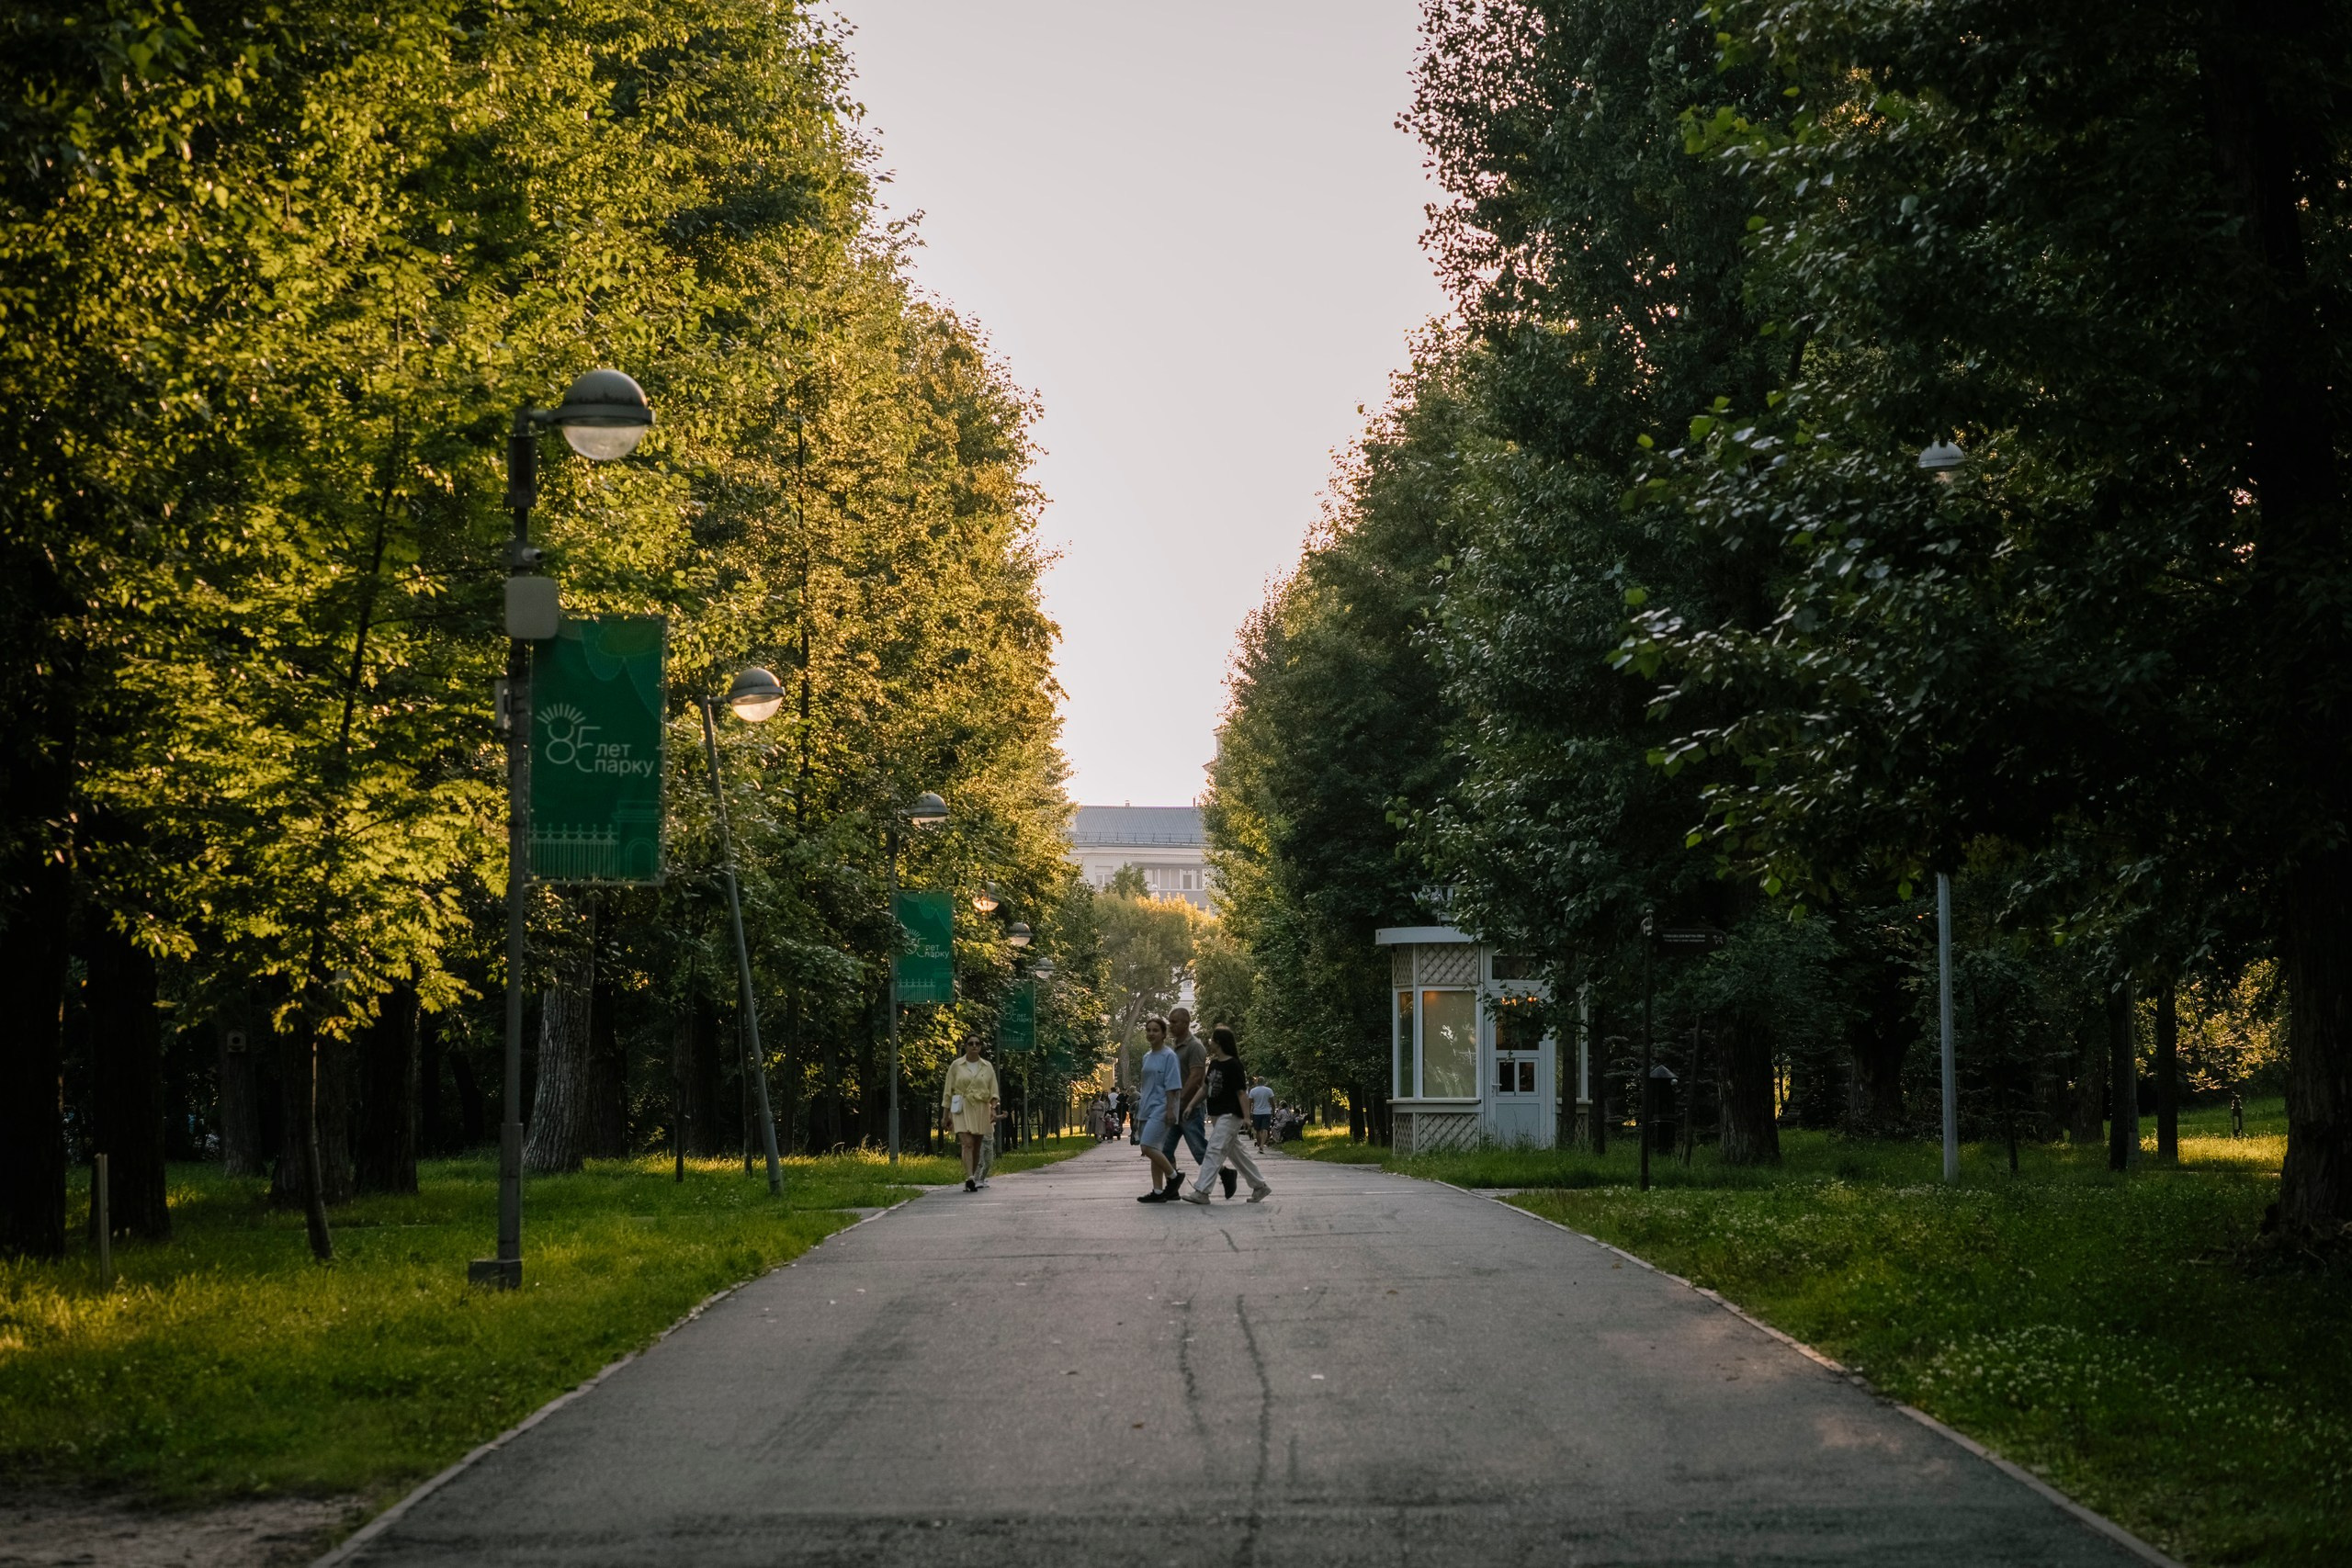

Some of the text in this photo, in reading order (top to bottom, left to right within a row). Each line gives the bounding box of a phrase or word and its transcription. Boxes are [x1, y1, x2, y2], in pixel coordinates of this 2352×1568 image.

[545, 716, 632, 773] 85 лет
[594, 759, 655, 778] парку
[924, 951, 950, 959] парку
